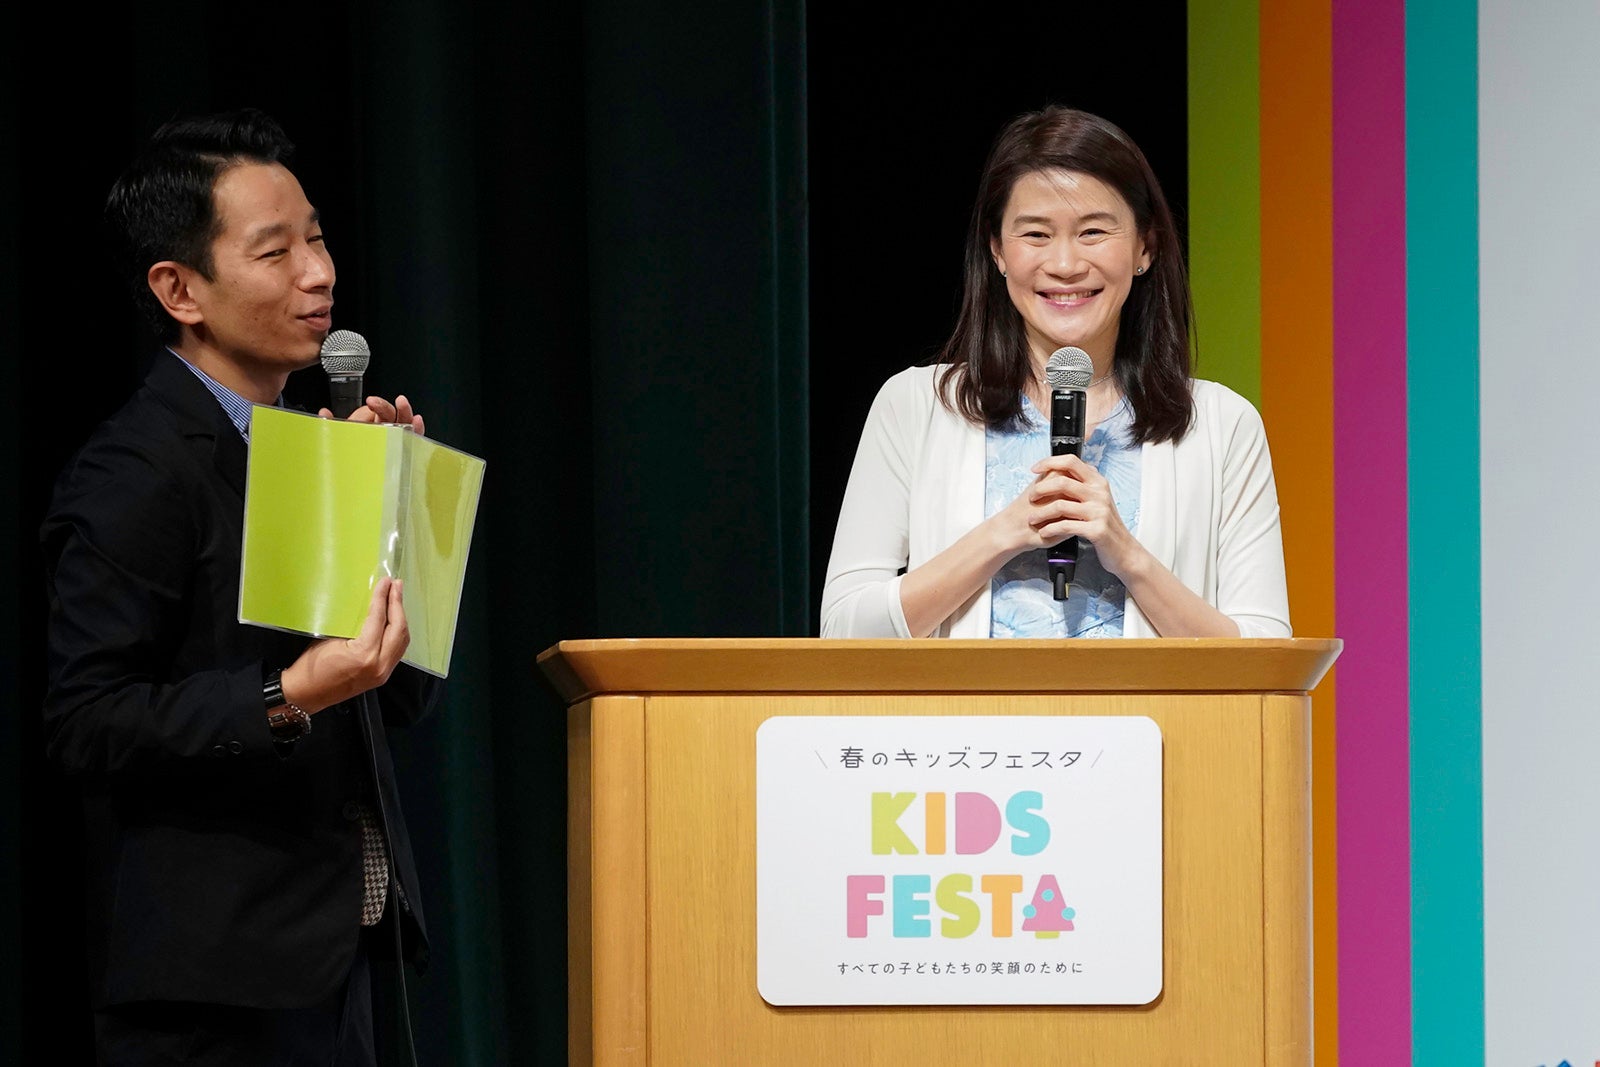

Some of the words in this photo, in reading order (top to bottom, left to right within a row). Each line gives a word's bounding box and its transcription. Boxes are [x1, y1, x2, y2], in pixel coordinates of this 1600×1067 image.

[840, 746, 1082, 769] 春のキッズフェスタ
[871, 790, 1051, 857] KIDS
[847, 873, 1076, 939] FESTA
[837, 961, 1082, 975] すべての子どもたちの笑顔のために
